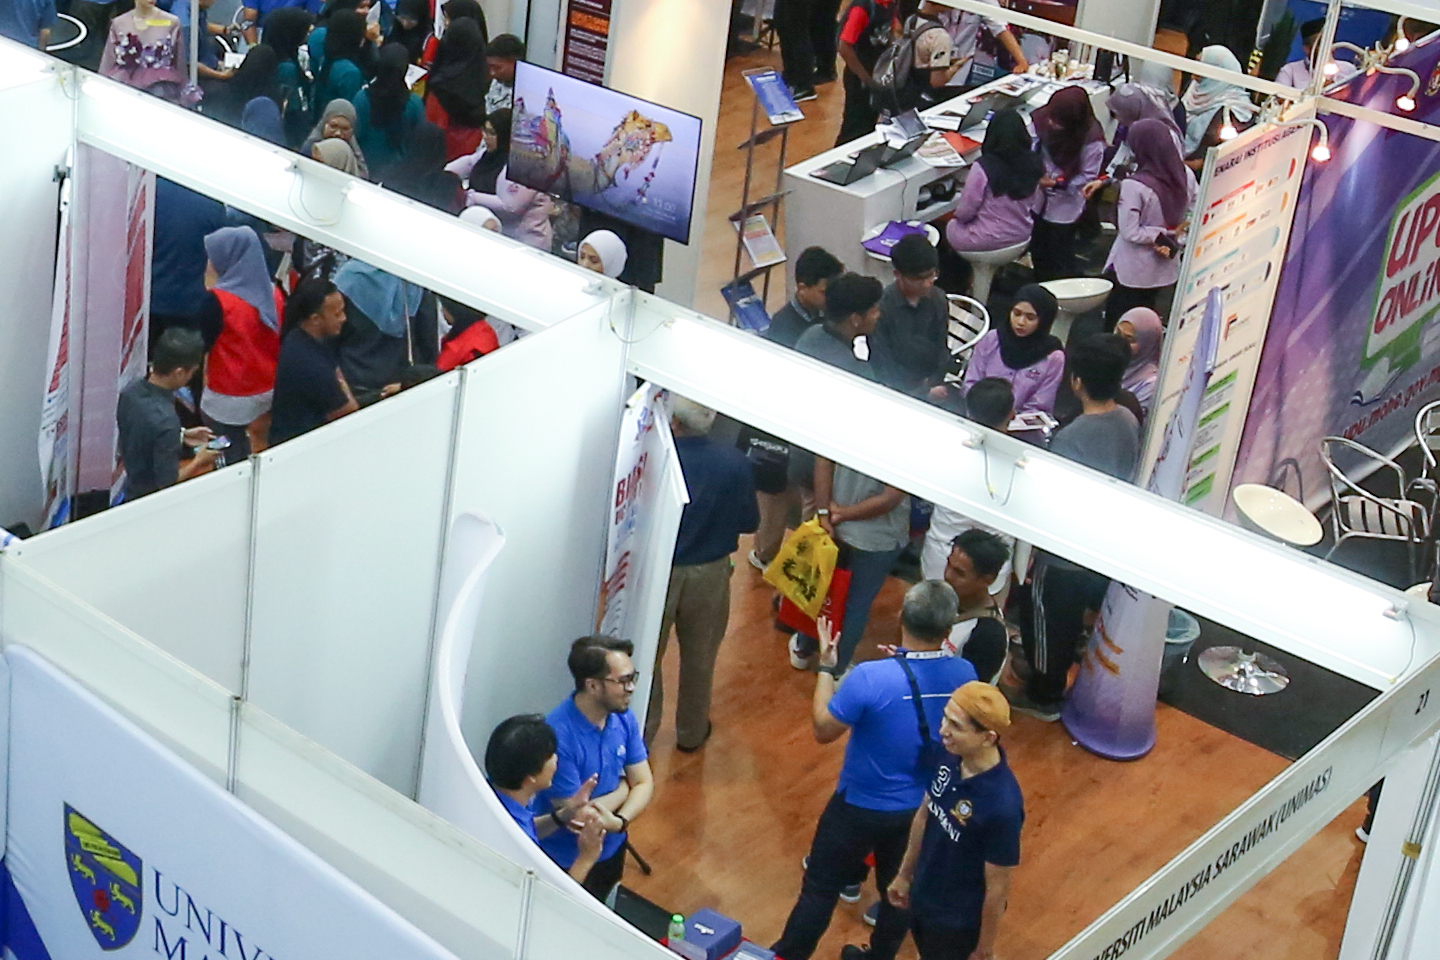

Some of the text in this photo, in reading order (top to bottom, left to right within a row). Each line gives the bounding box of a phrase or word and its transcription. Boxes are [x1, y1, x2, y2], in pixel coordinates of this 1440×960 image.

[1414, 689, 1430, 716] 21
[1146, 764, 1335, 933] MALAYSIA SARAWAK (UNIMAS)
